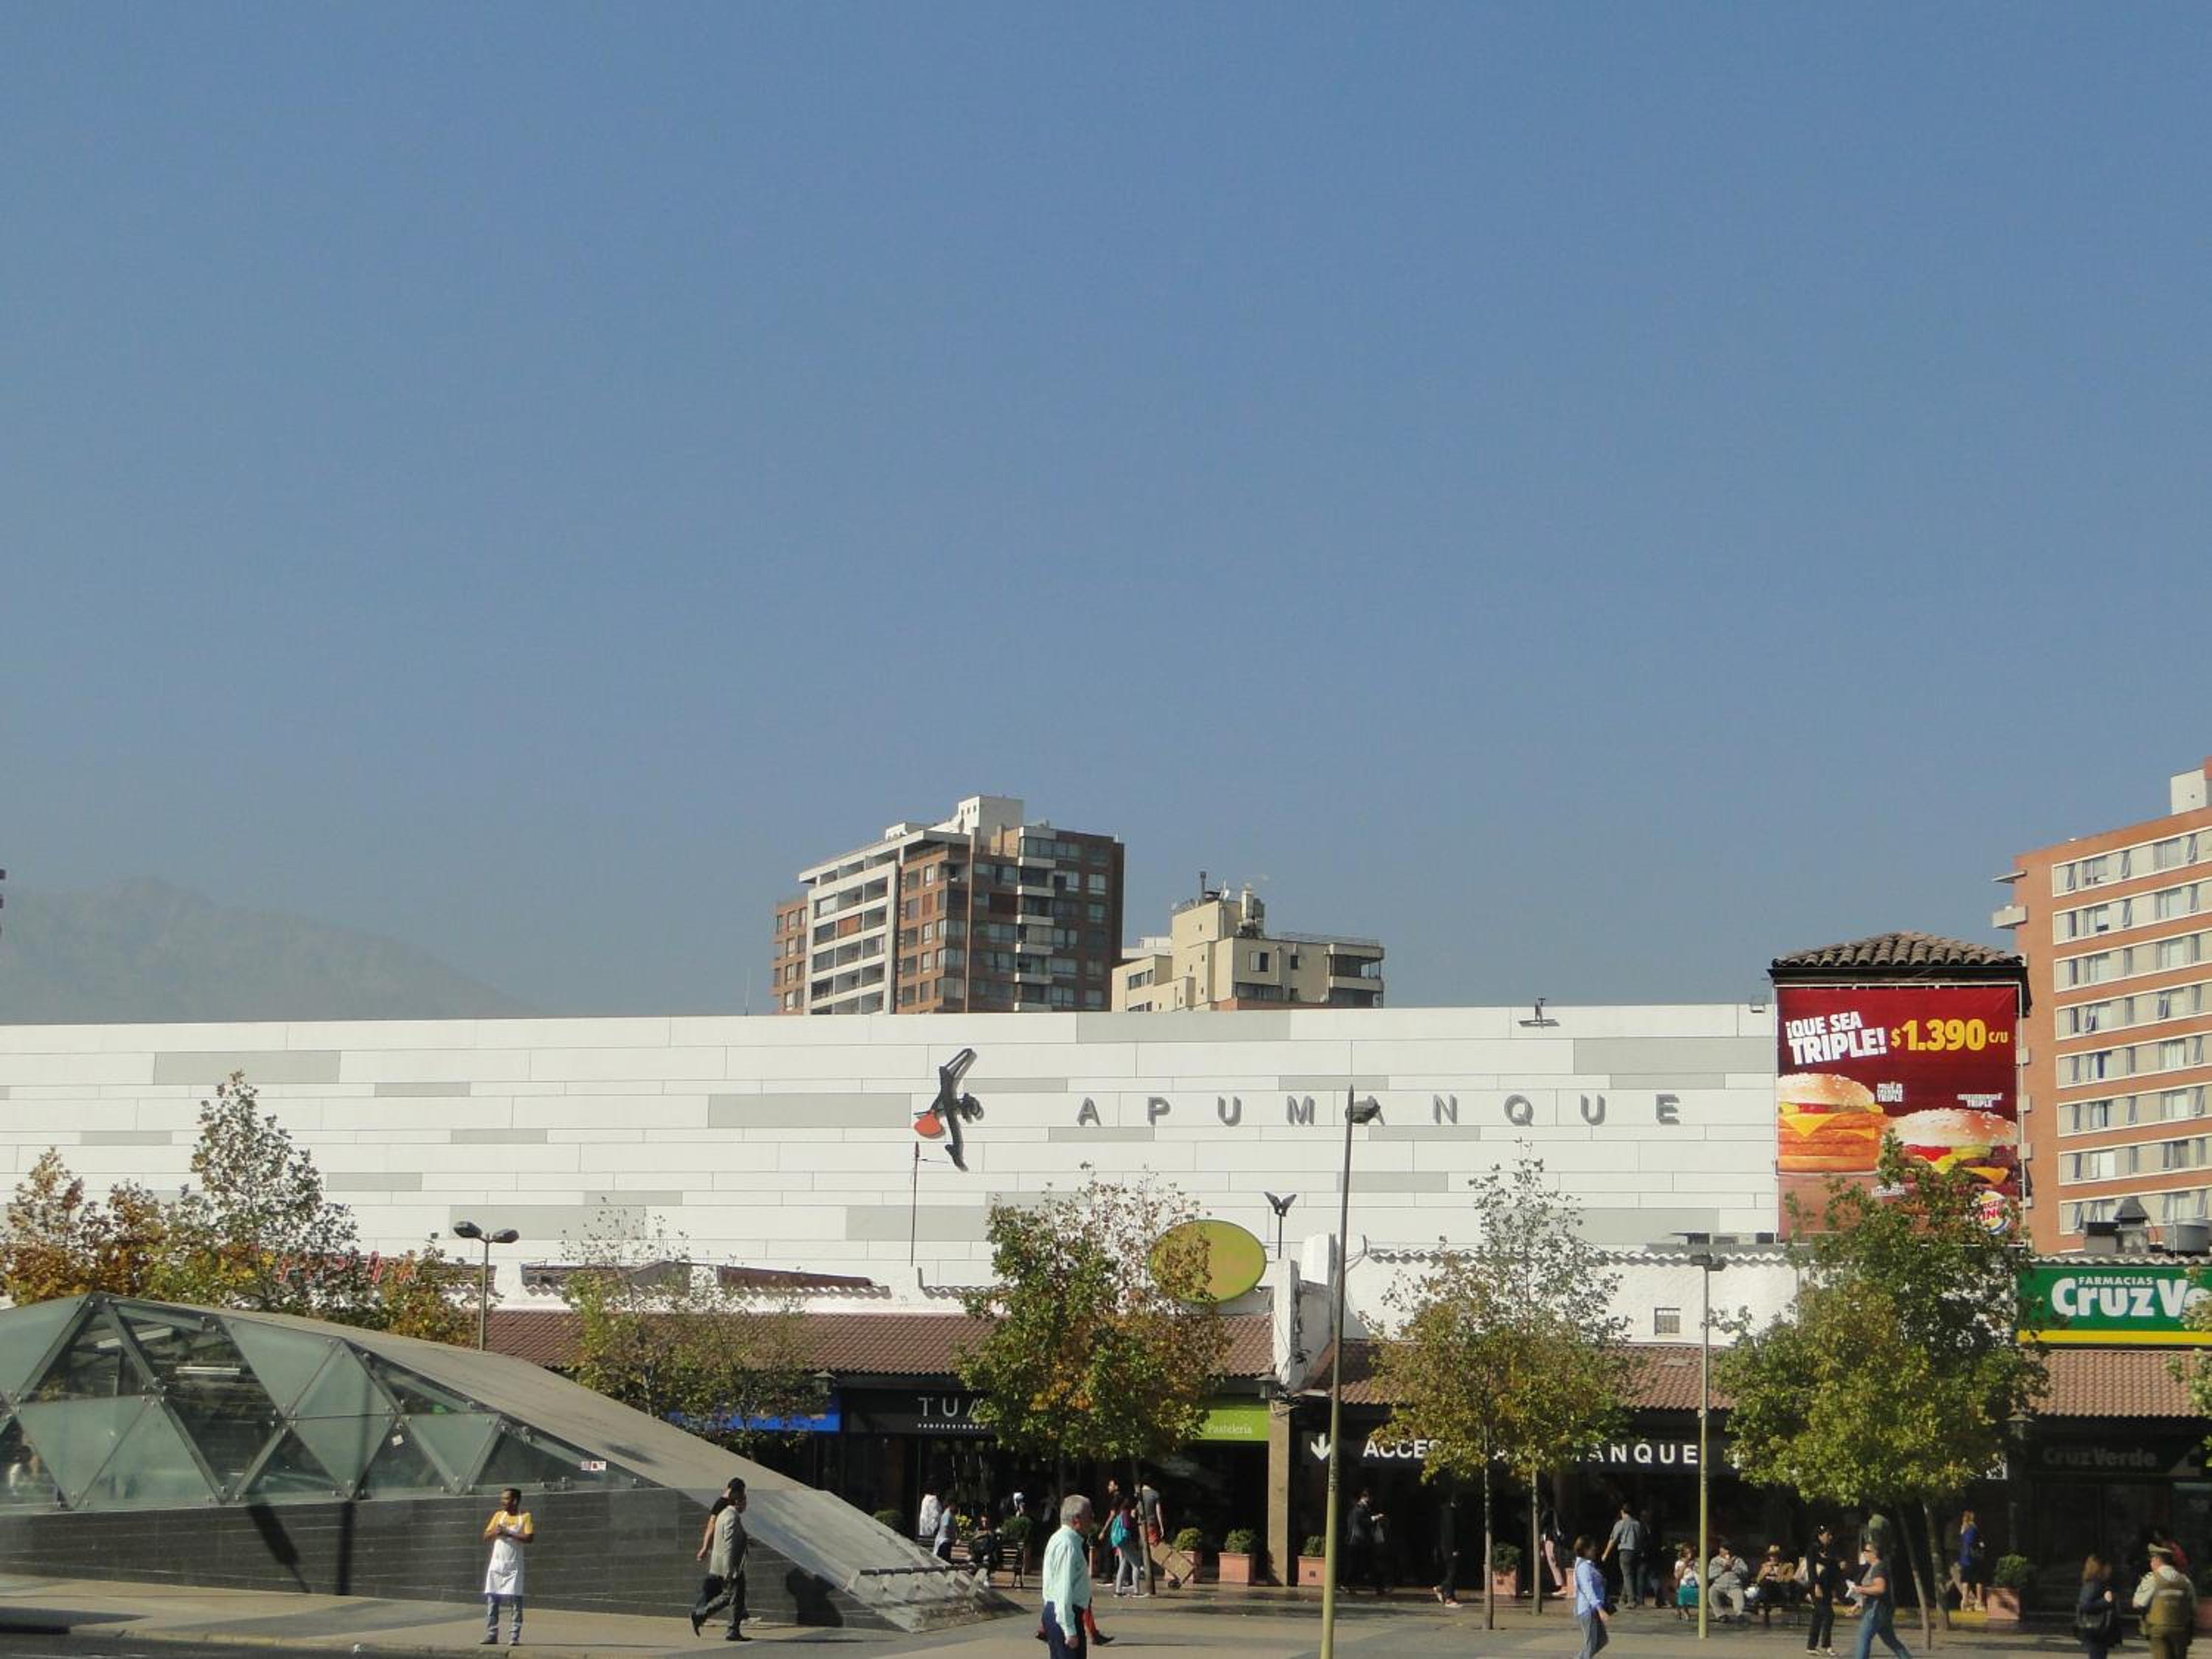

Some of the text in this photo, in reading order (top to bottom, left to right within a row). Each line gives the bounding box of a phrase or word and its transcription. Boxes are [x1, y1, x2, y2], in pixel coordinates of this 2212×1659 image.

[1785, 1011, 1863, 1039] ¡QUE SEA
[1891, 1019, 1986, 1051] $1.390
[1788, 1027, 1888, 1065] TRIPLE!
[2079, 1276, 2154, 1286] FARMACIAS
